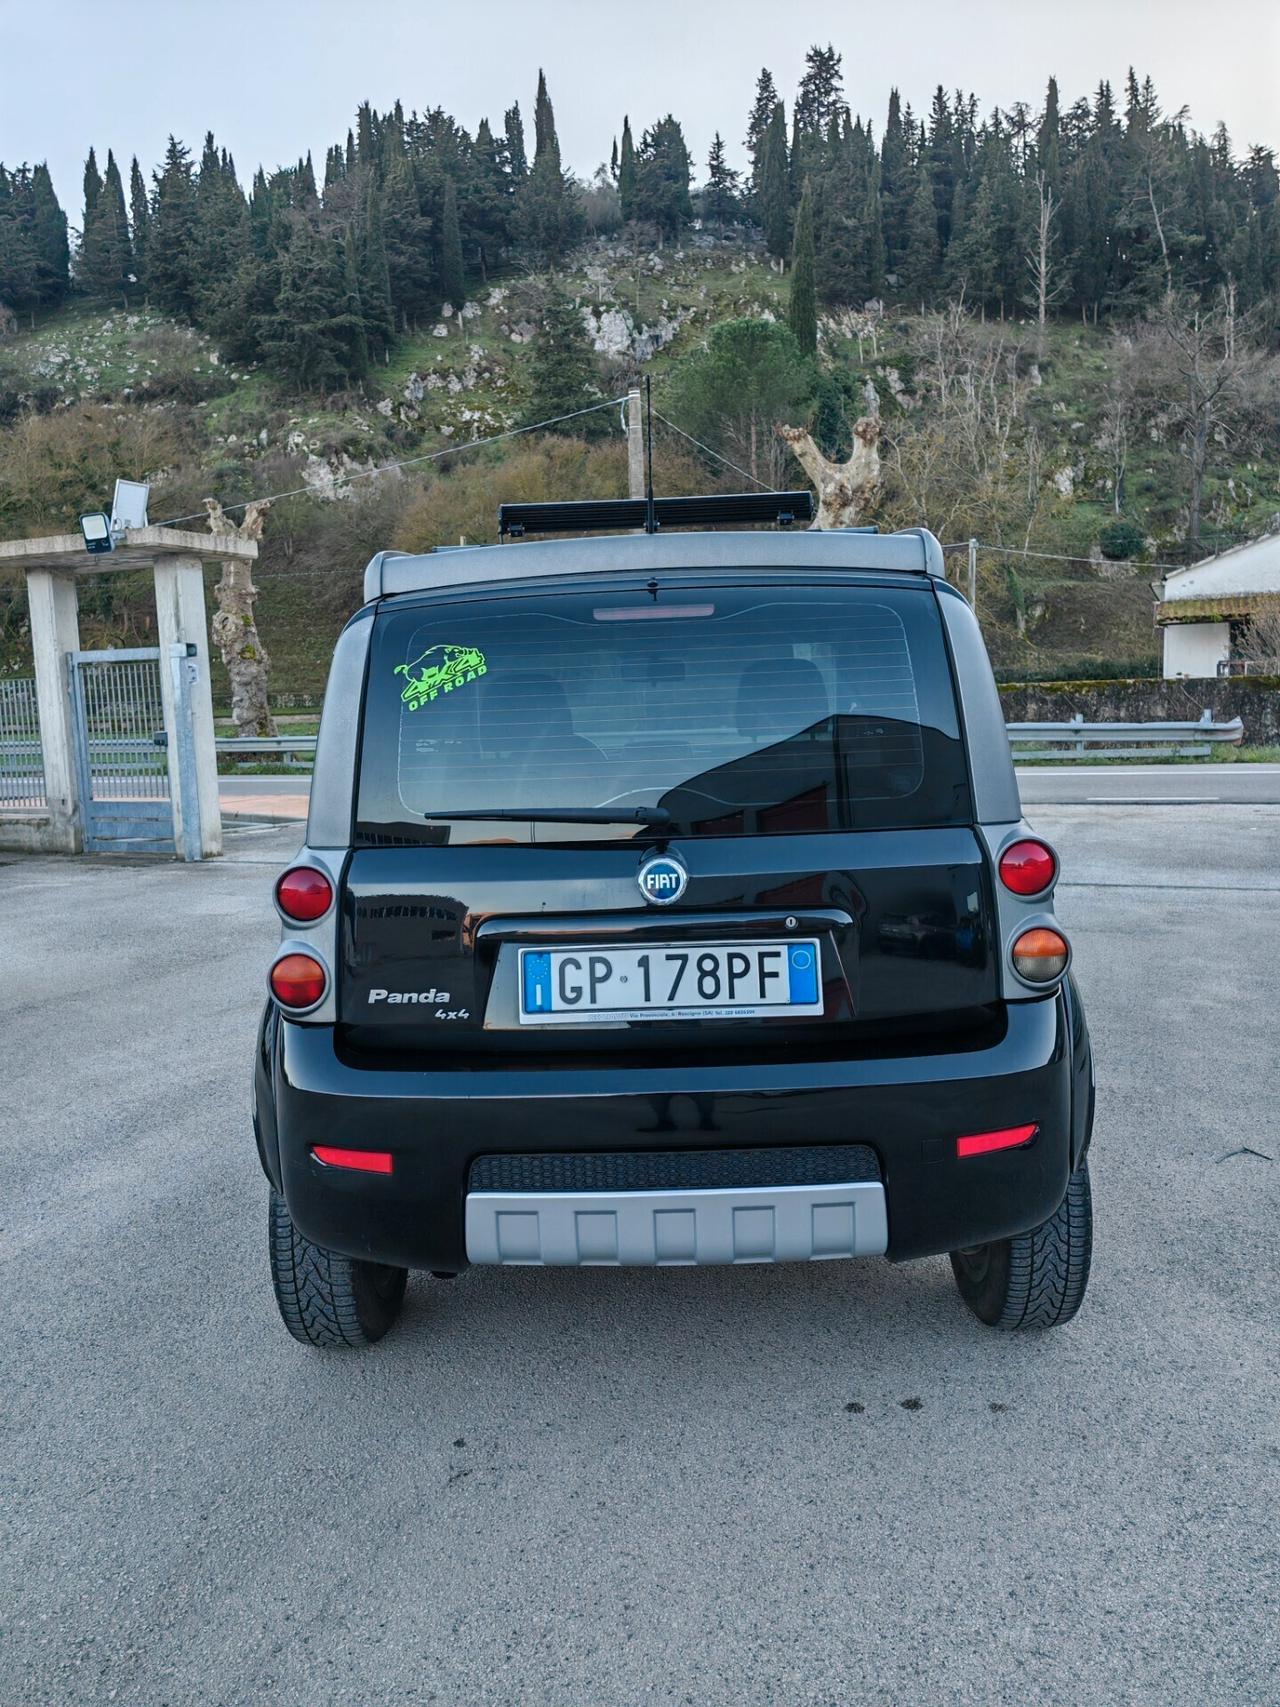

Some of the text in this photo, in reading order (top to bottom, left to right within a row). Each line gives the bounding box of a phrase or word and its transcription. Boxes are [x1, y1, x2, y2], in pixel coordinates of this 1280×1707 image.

[408, 665, 488, 711] OFF ROAD
[647, 874, 678, 889] FIAT
[558, 956, 613, 1004] GP
[637, 951, 782, 1002] 178PF
[367, 988, 451, 1004] Panda
[434, 1008, 470, 1019] 4x4
